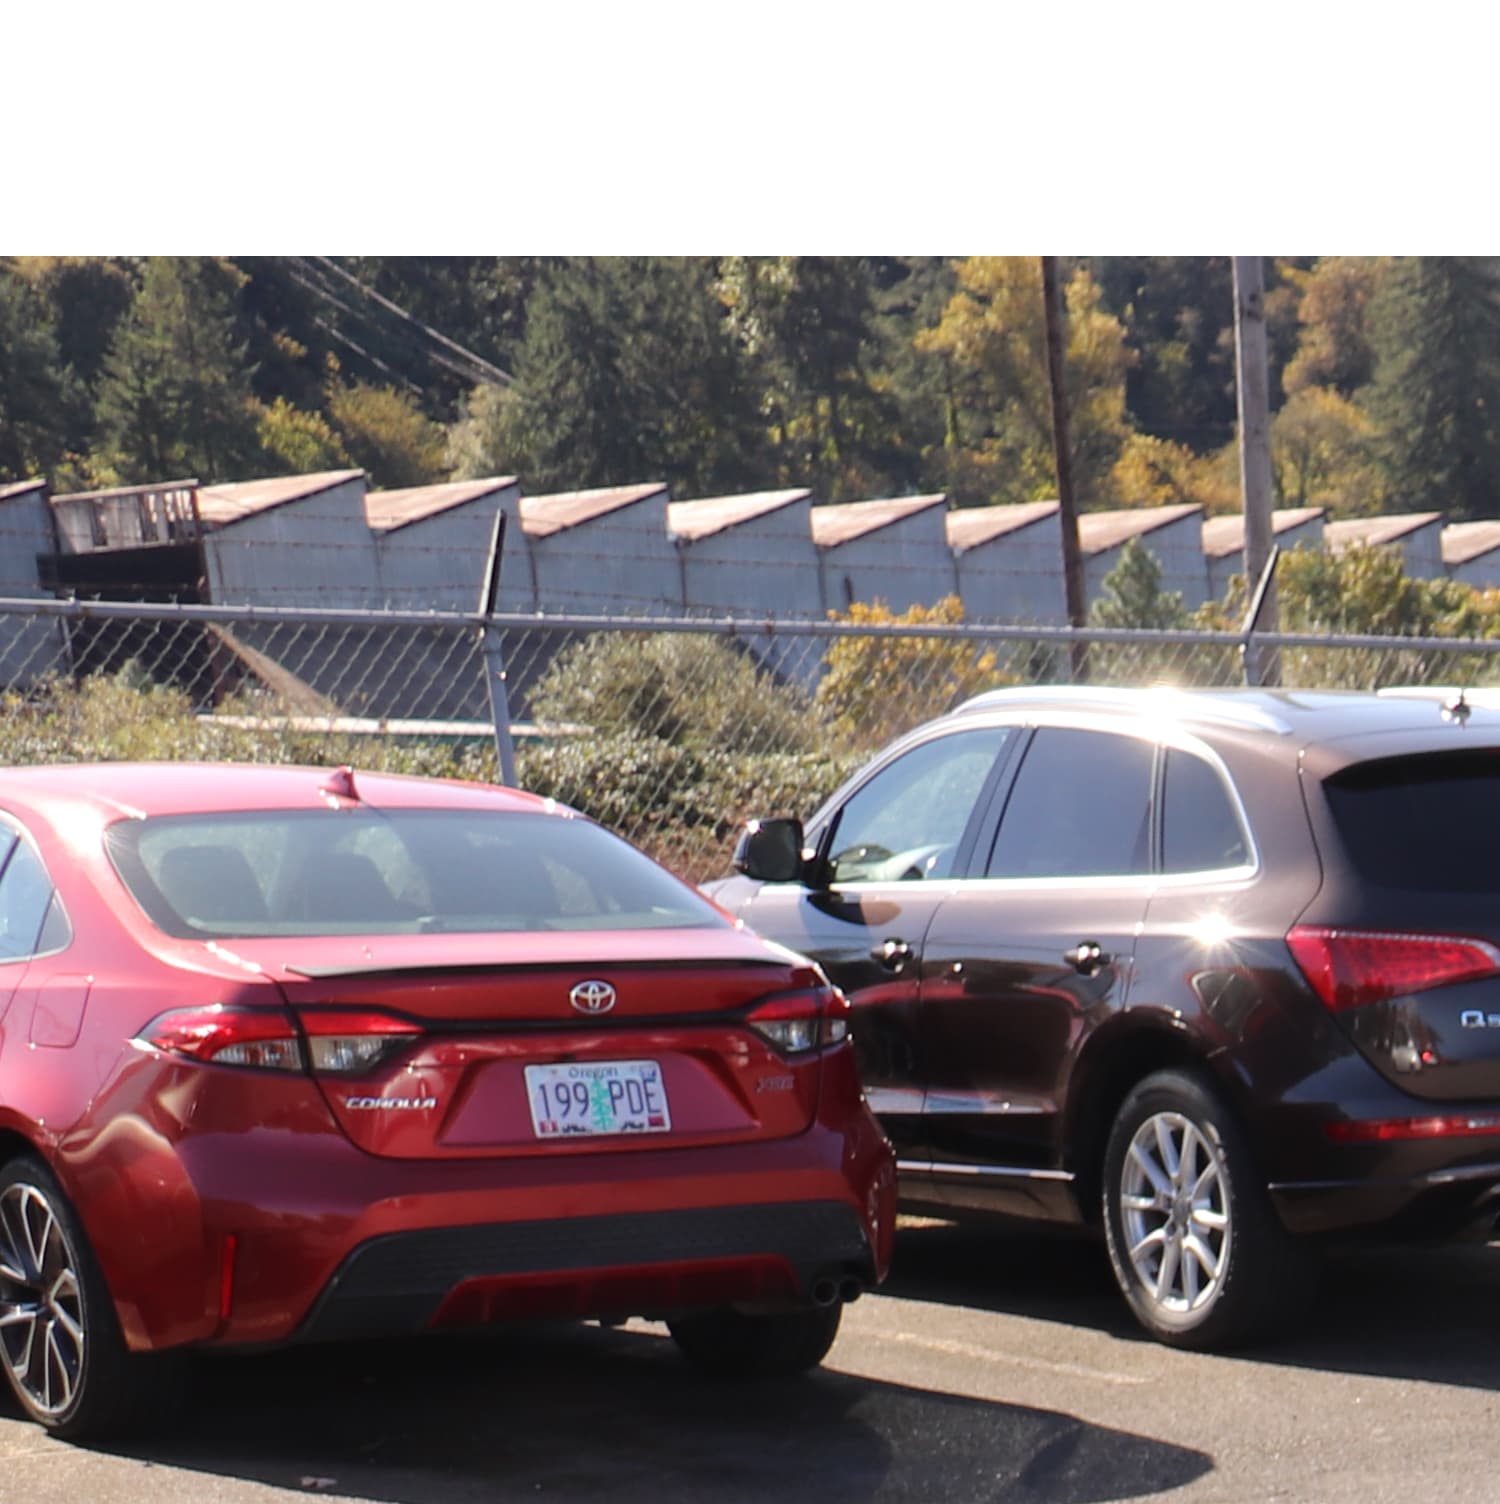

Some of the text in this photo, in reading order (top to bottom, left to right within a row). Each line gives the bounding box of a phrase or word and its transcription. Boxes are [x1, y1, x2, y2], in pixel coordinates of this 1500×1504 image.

[345, 1096, 436, 1109] COROLLA
[539, 1077, 662, 1119] 199 PDE
